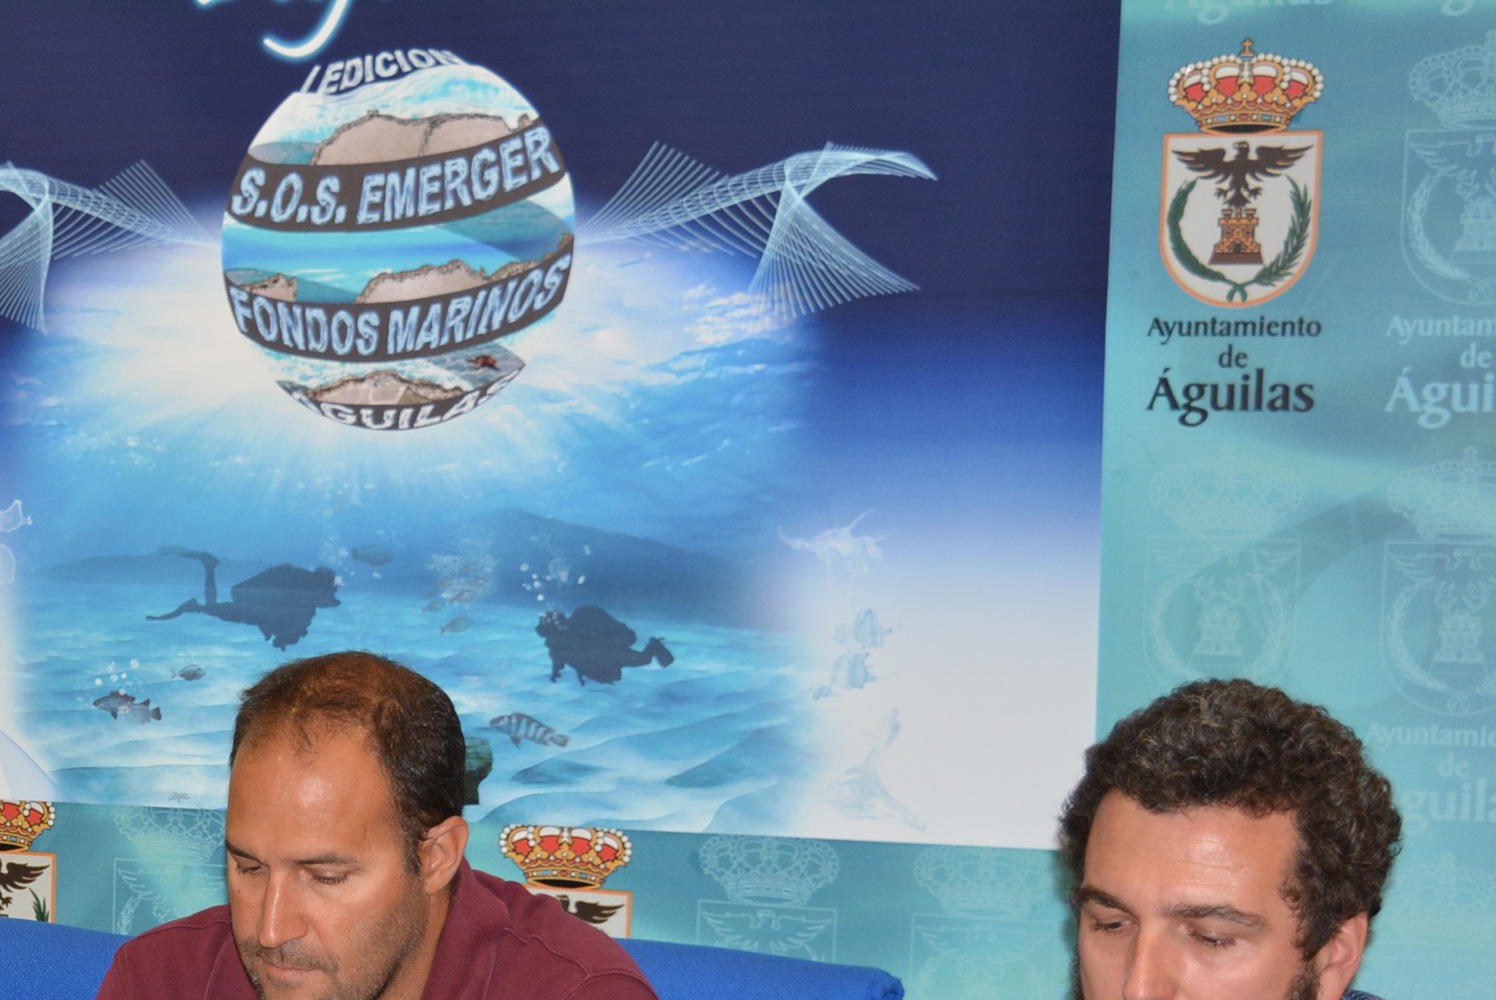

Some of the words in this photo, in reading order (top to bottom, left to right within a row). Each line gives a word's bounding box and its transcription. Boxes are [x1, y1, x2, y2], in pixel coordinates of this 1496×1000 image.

[316, 48, 469, 96] EDICION
[230, 166, 348, 227] S.O.S.
[356, 124, 563, 226] EMERGER
[227, 284, 381, 357] FONDOS
[386, 252, 573, 356] MARINOS
[1147, 316, 1322, 345] Ayuntamiento
[1384, 314, 1496, 345] Ayuntam
[1218, 344, 1248, 369] de
[1459, 342, 1493, 369] de
[1145, 367, 1316, 428] Águilas
[1383, 365, 1496, 429] Águi
[1437, 753, 1470, 779] de
